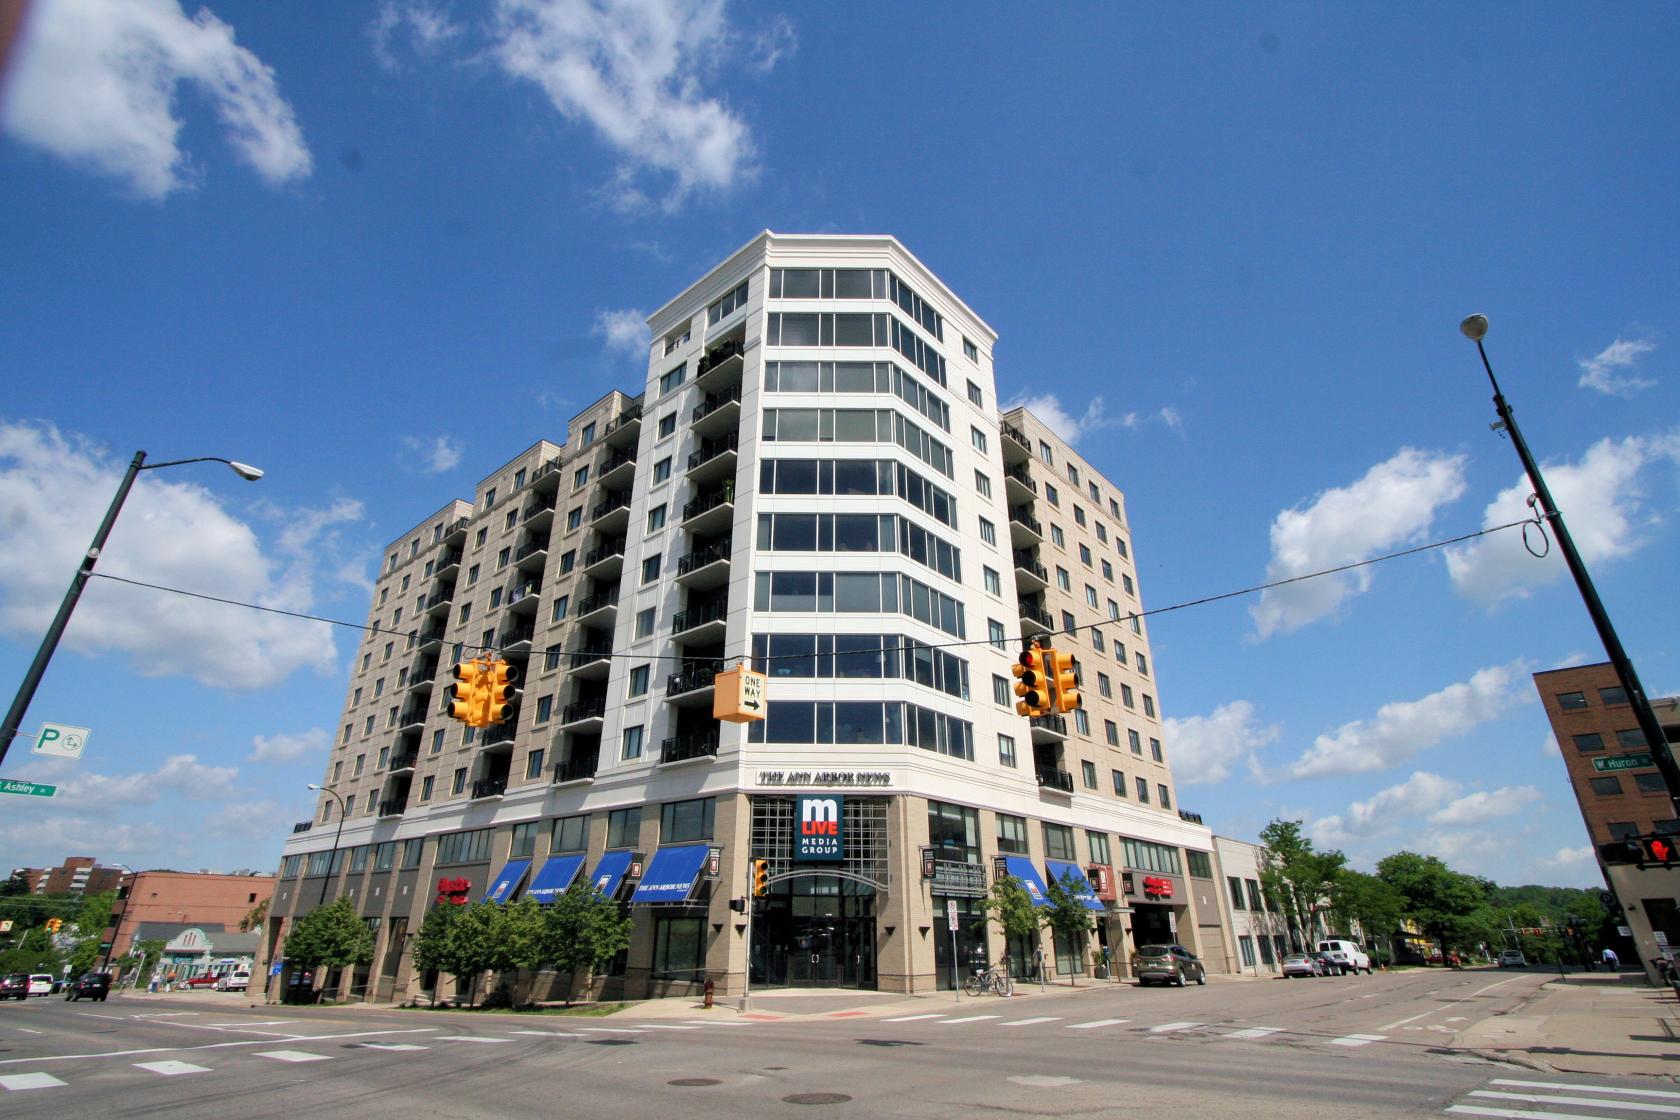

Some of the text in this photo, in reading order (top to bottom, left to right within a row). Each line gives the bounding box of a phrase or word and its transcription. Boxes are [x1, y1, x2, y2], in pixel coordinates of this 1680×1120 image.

[745, 675, 760, 687] ONE
[745, 686, 760, 698] WAY
[37, 728, 60, 748] P
[1595, 760, 1605, 769] W
[1608, 758, 1638, 769] Huron
[759, 771, 890, 784] THE ANN ARBOR NEWS
[4, 782, 35, 795] Ashley
[802, 799, 838, 822] m
[802, 821, 839, 835] LIVE
